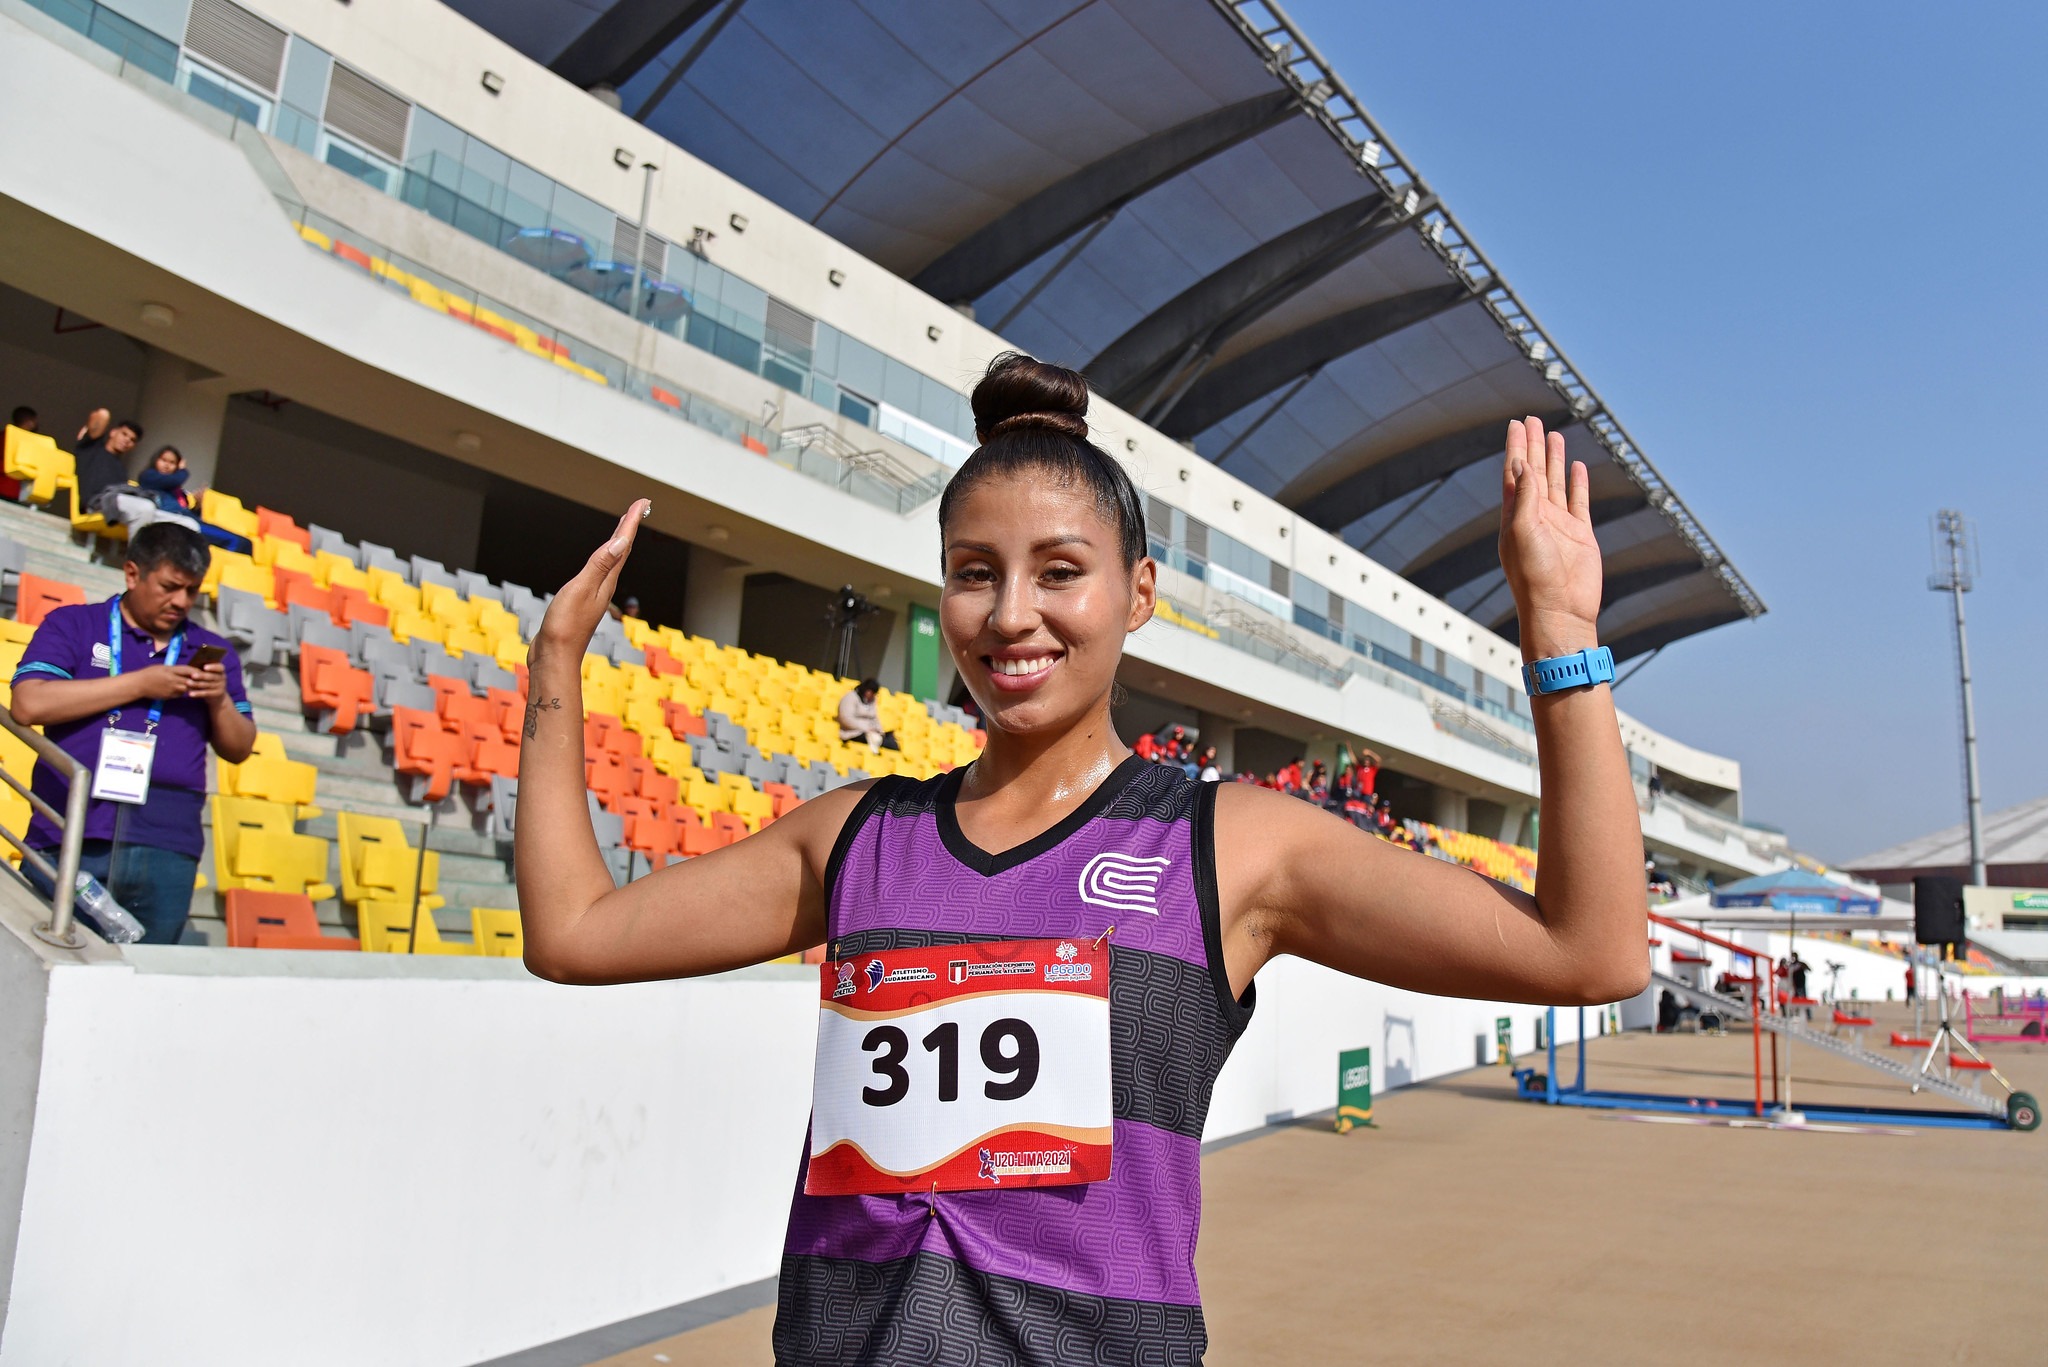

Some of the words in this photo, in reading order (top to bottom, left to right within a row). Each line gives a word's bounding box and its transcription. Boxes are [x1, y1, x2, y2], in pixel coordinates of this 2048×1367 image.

[892, 968, 928, 976] ATLETISMO
[884, 973, 936, 983] SUDAMERICANO
[833, 986, 856, 997] ATHLETICS
[861, 1017, 1041, 1107] 319
[1044, 1151, 1070, 1166] 2021
